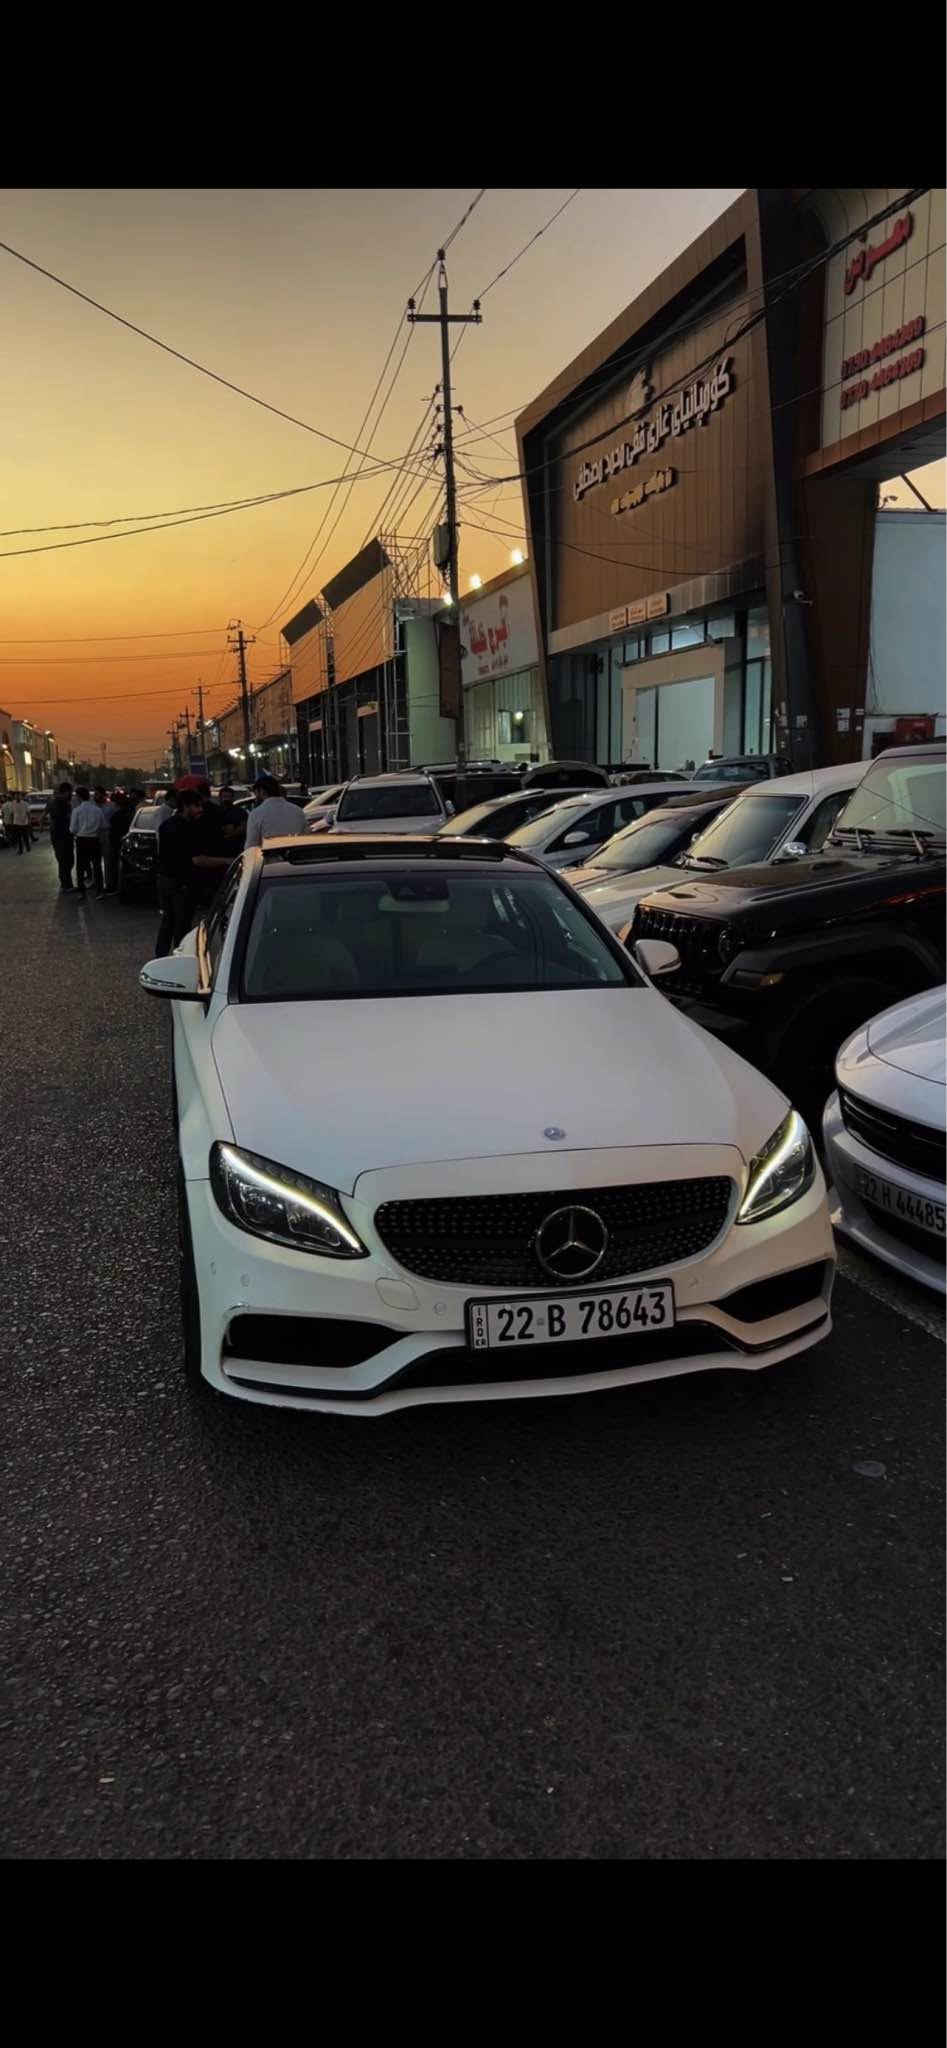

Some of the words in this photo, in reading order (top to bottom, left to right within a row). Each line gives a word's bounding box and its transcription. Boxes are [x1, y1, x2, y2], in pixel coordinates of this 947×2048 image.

[882, 1184, 892, 1207] H
[497, 1307, 534, 1341] 22
[547, 1304, 566, 1337] B
[579, 1292, 666, 1334] 78643
